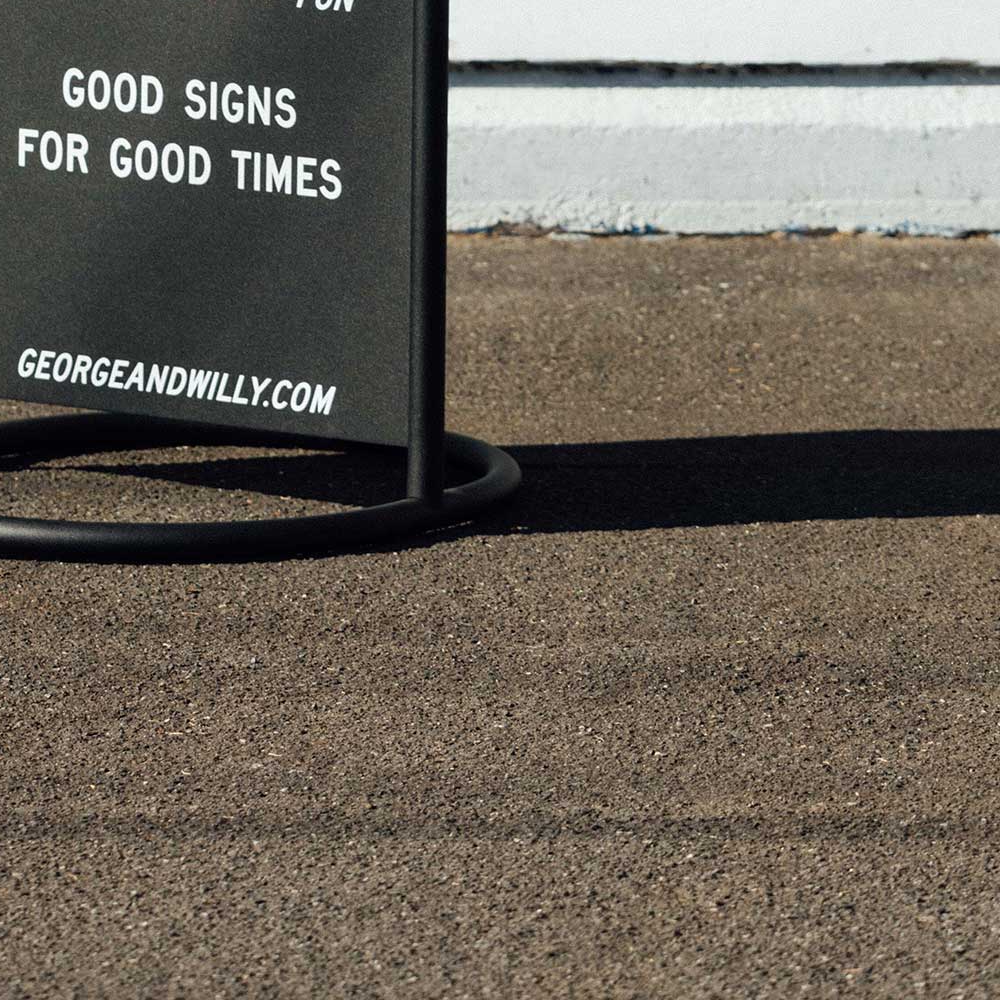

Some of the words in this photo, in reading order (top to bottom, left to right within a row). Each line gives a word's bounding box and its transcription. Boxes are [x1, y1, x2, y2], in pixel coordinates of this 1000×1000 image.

[62, 67, 164, 115] GOOD
[184, 79, 297, 128] SIGNS
[18, 128, 88, 174] FOR
[110, 138, 211, 185] GOOD
[231, 150, 342, 200] TIMES
[17, 347, 336, 416] GEORGEANDWILLY.COM
